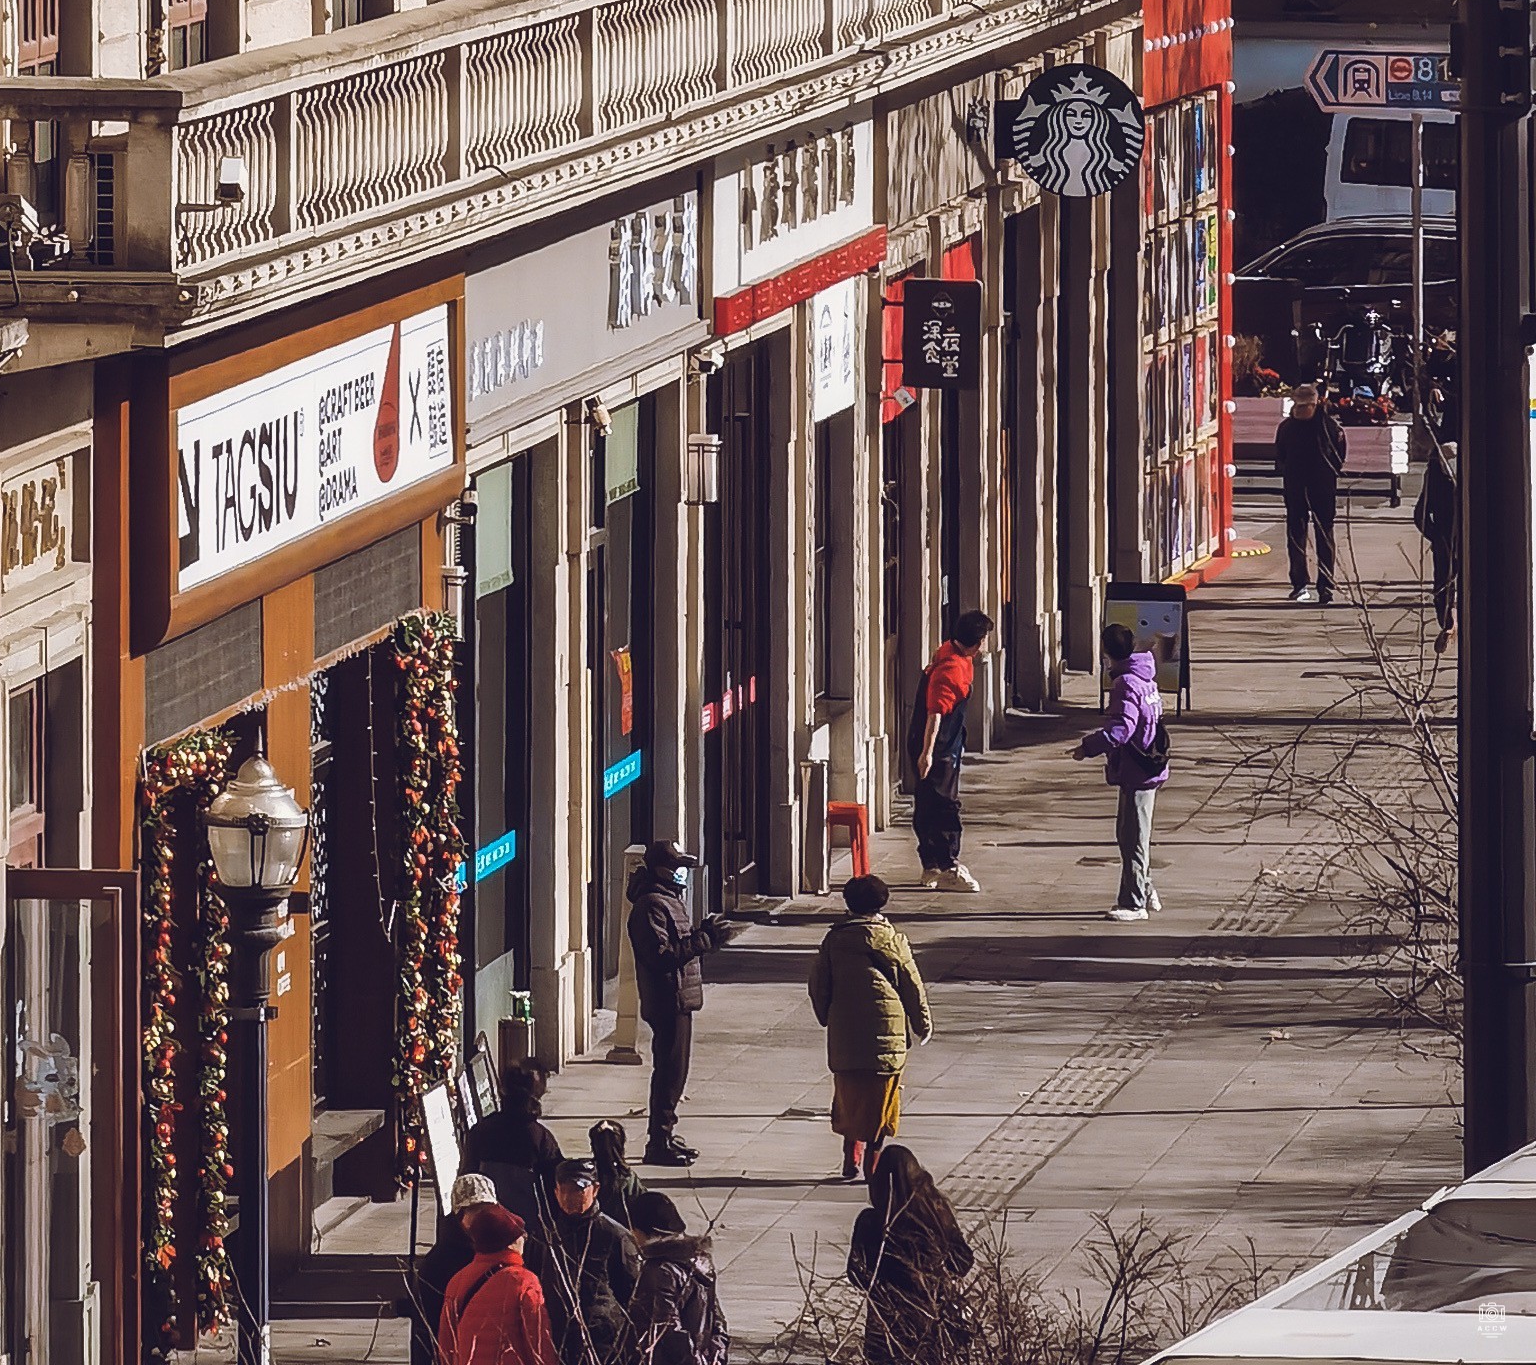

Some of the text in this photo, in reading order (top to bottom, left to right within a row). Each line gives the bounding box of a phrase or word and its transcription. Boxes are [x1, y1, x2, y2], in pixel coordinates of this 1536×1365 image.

[1417, 57, 1433, 81] 8
[354, 372, 375, 412] BEER
[211, 410, 299, 554] TAGSIU
